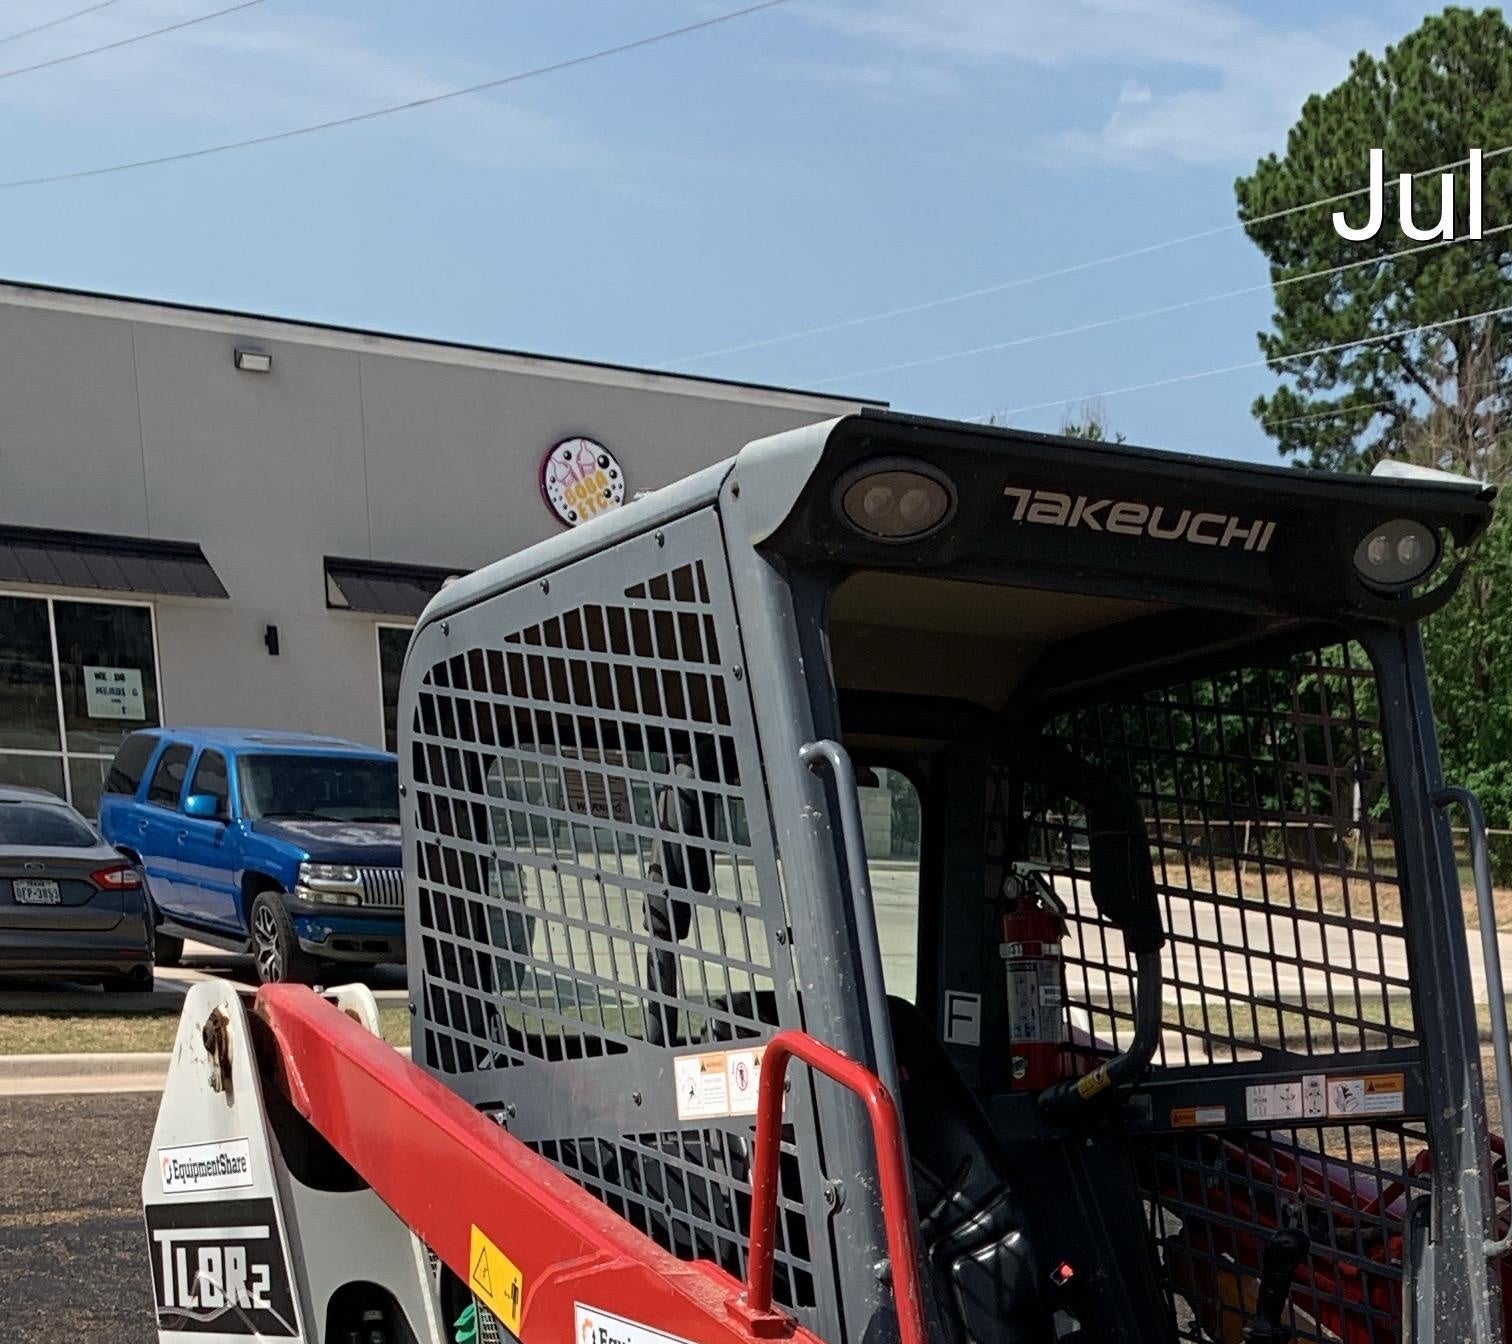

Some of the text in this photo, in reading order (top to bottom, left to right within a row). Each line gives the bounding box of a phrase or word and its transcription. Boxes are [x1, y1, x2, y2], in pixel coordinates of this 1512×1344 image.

[564, 470, 608, 506] BOBA
[948, 992, 978, 1038] F
[172, 1153, 247, 1185] EquipmentShare
